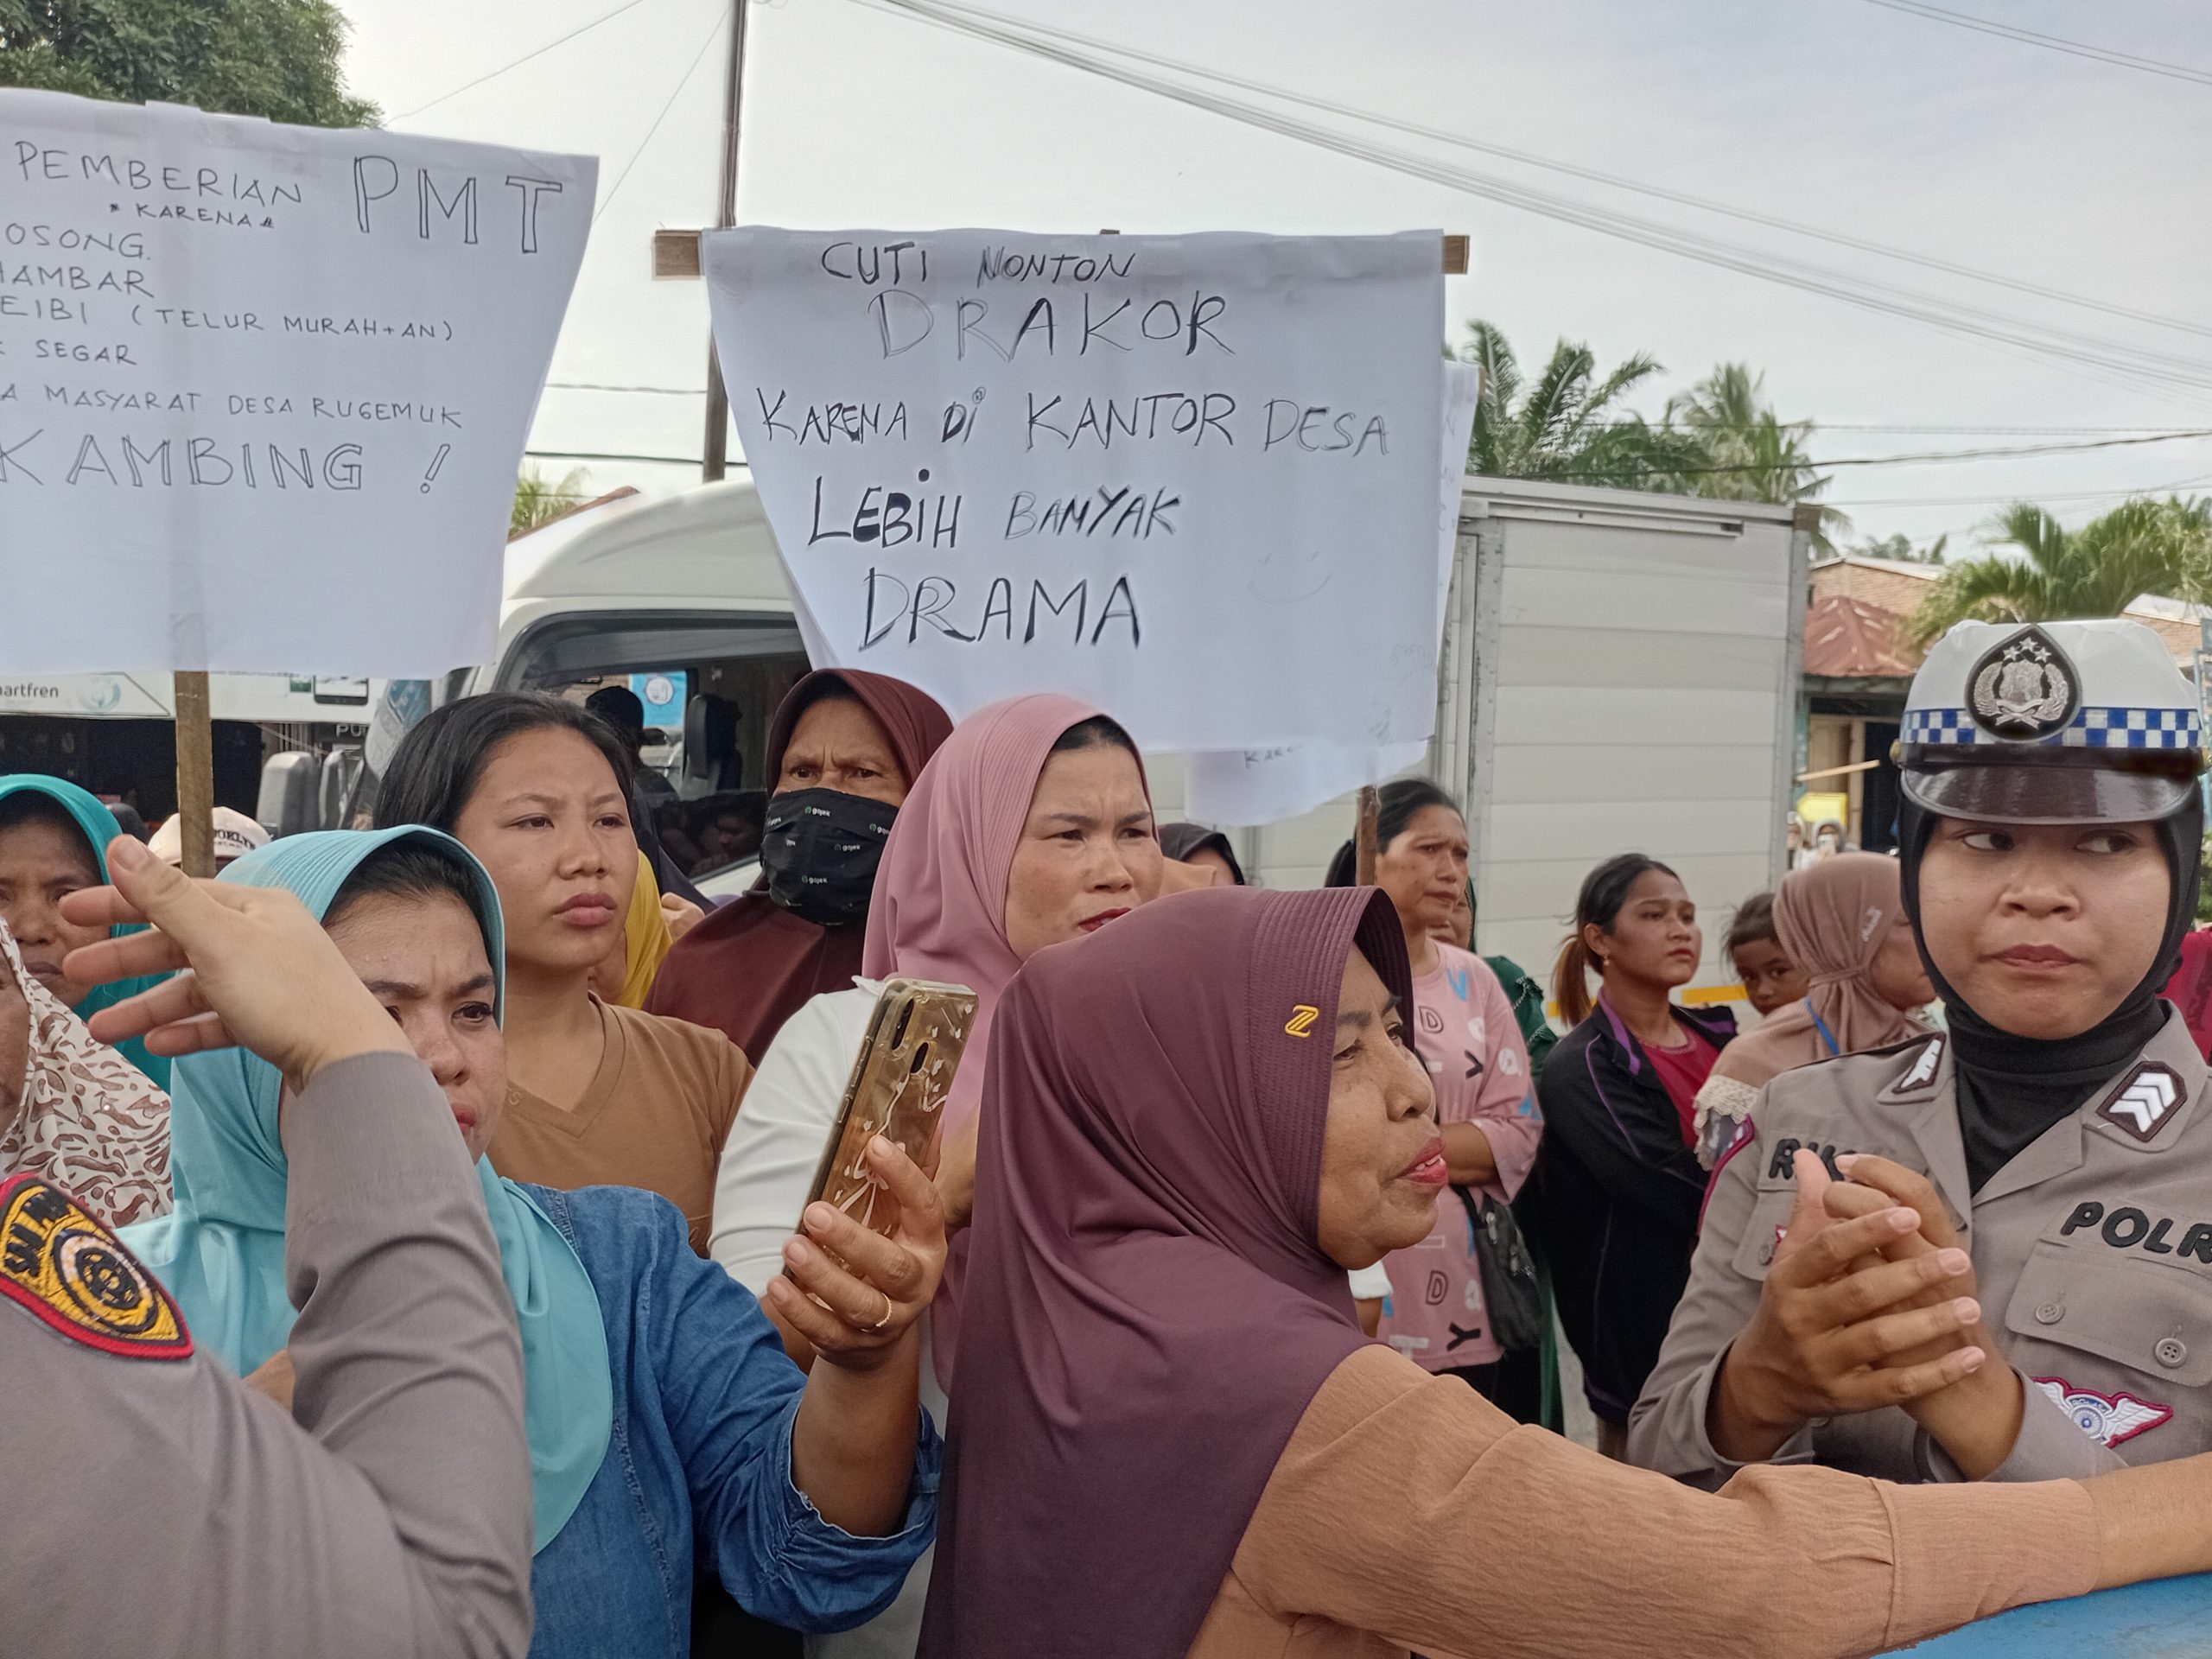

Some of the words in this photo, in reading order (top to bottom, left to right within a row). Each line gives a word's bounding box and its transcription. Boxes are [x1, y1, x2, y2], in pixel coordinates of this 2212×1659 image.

[14, 141, 302, 207] PEMBERIAN
[353, 155, 563, 254] PMT
[821, 241, 928, 286] CUTI
[977, 245, 1137, 289] NONTON
[131, 304, 264, 330] (TELUR
[868, 289, 1236, 364] DRAKOR
[35, 339, 137, 365] SEGAR
[44, 385, 201, 411] MASYARAT
[228, 394, 293, 415] DESA
[313, 397, 462, 429] RUGEMUK
[756, 387, 907, 446] KARENA
[1026, 391, 1236, 454] KANTOR
[1262, 398, 1391, 457] DESA
[0, 429, 362, 491] KAMBING
[1004, 484, 1185, 541] BANYAK
[858, 566, 1141, 652] DRAMA
[0, 682, 59, 698] artfren
